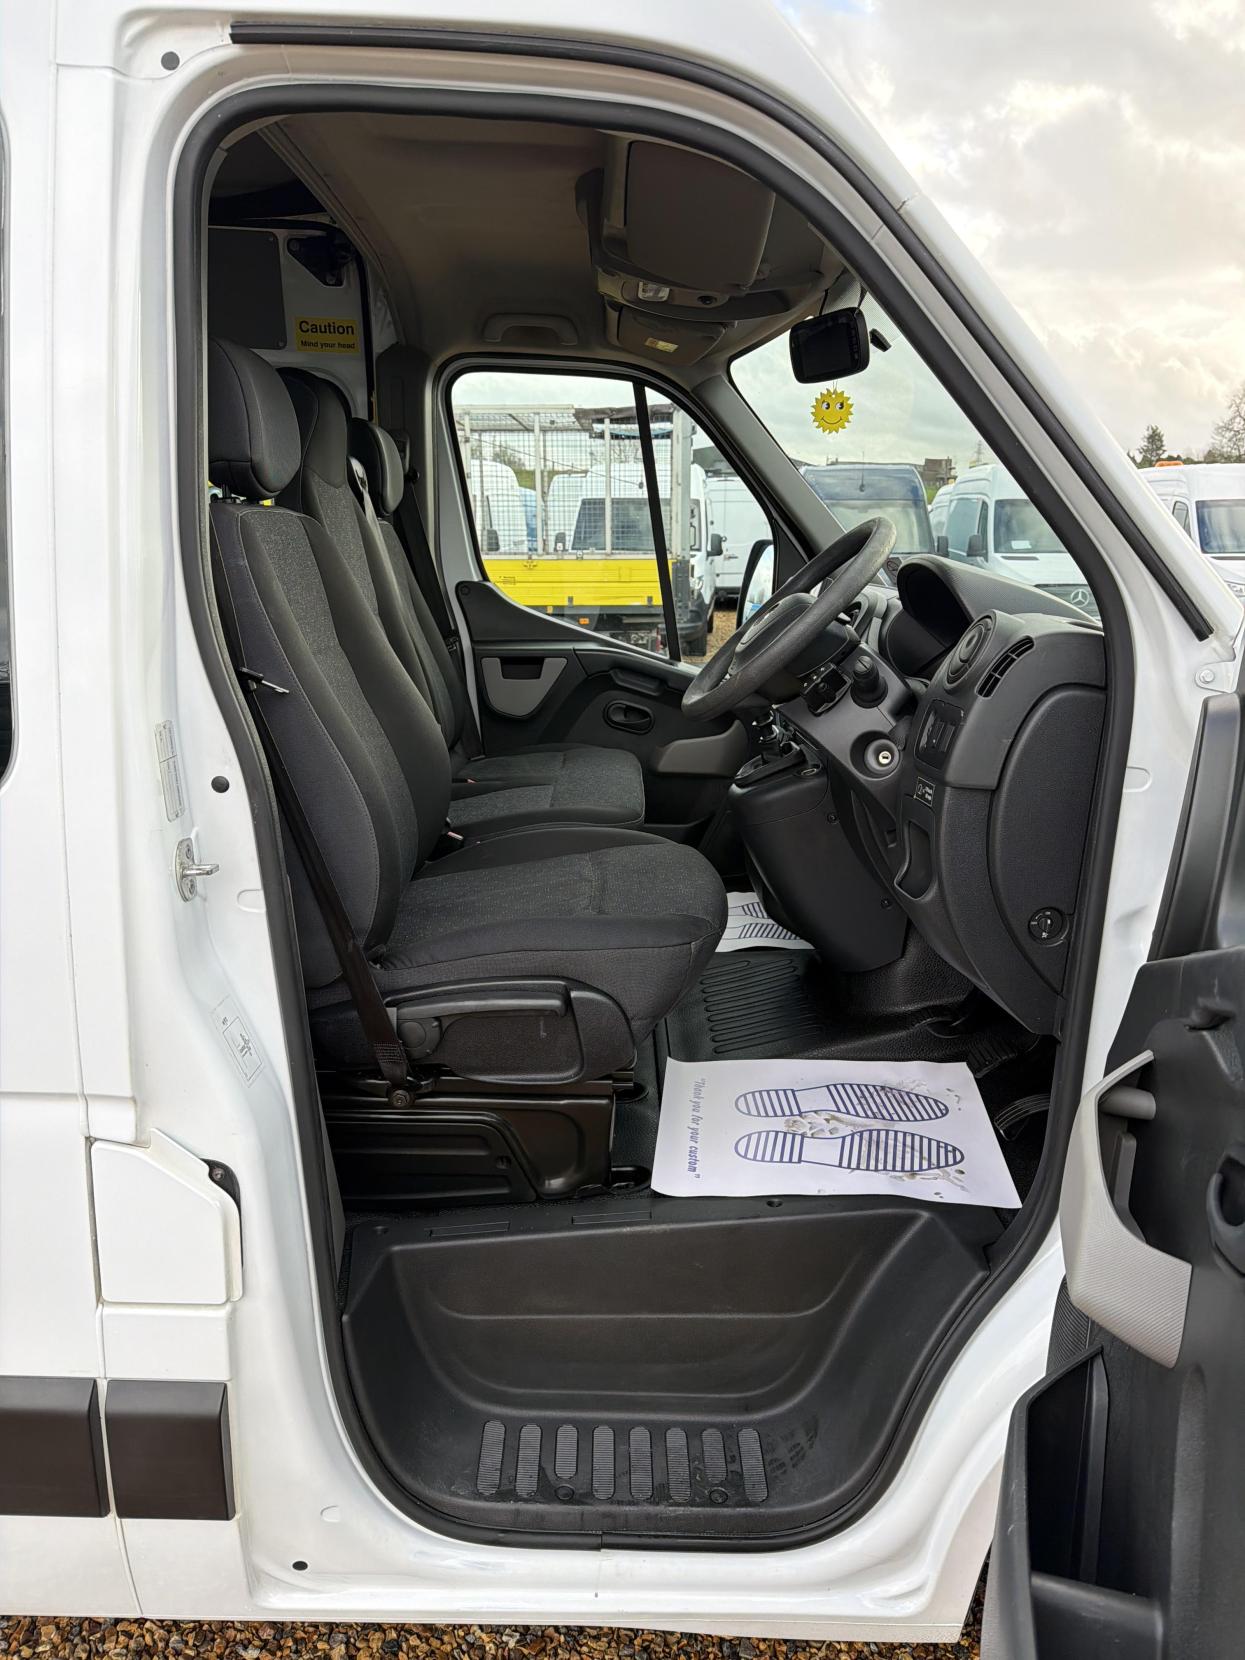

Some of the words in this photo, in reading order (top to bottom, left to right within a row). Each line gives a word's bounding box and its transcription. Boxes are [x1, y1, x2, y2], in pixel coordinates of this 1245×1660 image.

[299, 320, 355, 335] Caution
[300, 340, 319, 348] Mind
[337, 341, 356, 349] head
[689, 1099, 702, 1113] you
[691, 1113, 703, 1126] for
[687, 1126, 700, 1144] your
